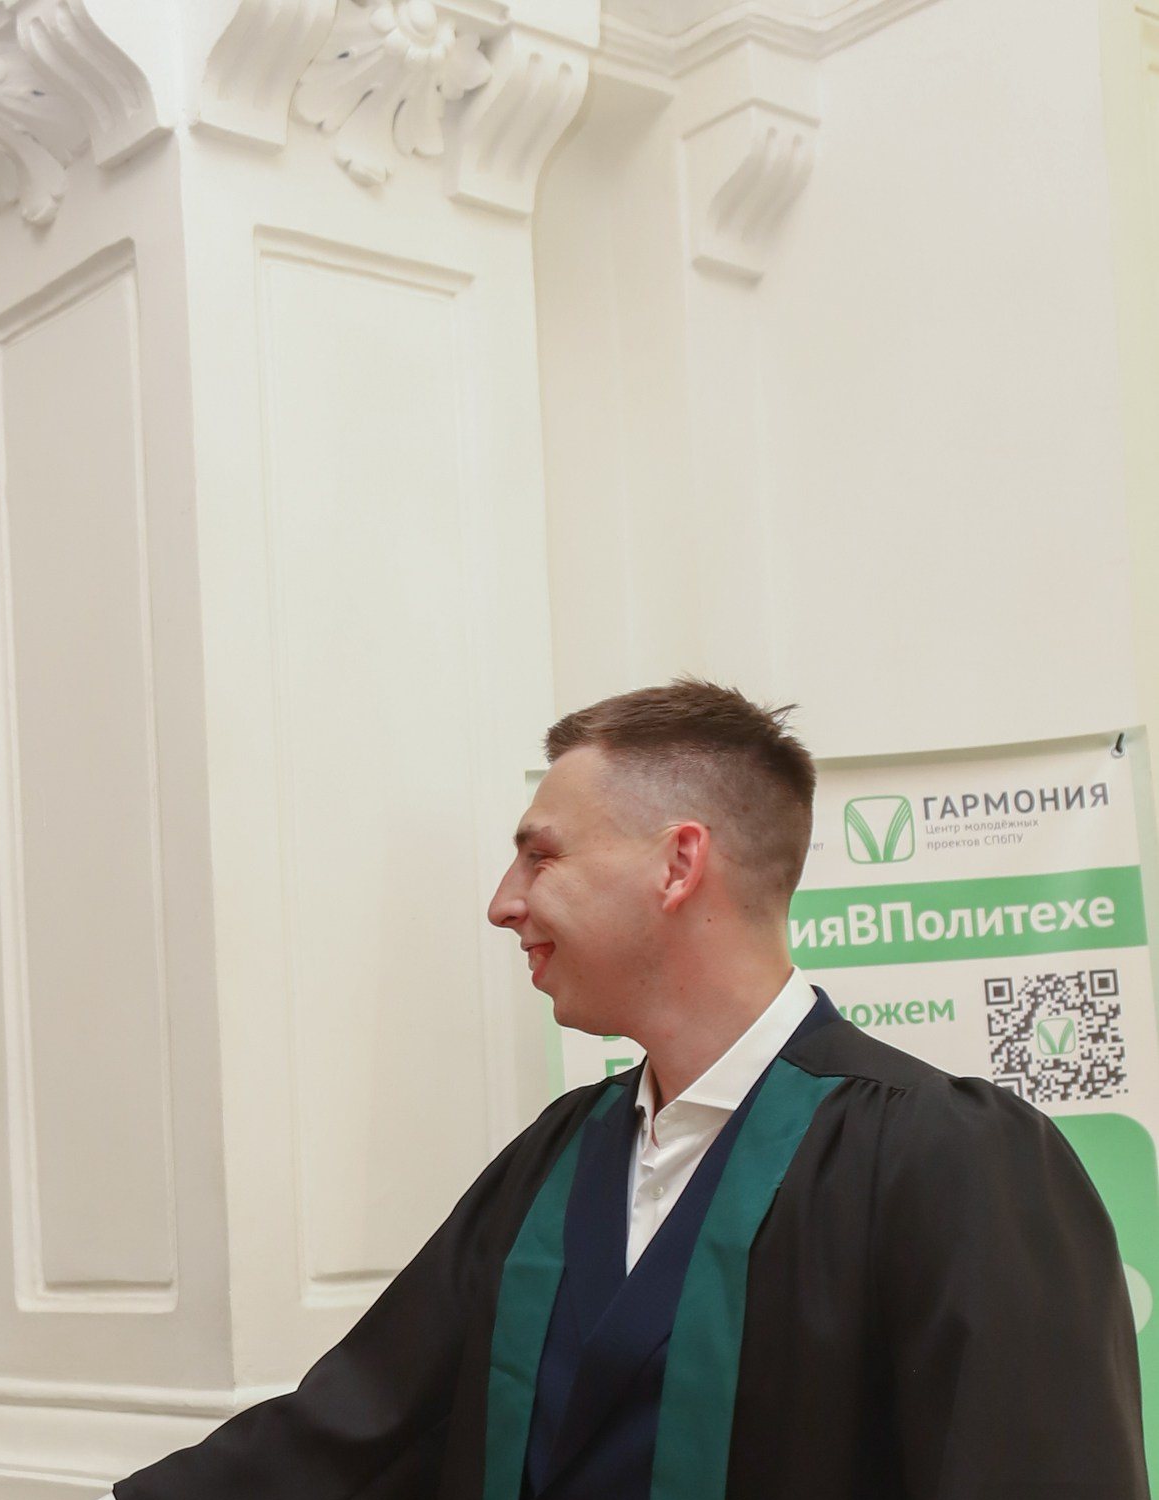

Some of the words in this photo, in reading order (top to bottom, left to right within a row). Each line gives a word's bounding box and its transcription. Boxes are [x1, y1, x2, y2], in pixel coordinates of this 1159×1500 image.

[922, 782, 1110, 821] ГАРМОНИЯ
[925, 823, 961, 835] Центр
[964, 818, 1040, 832] молодёжных
[926, 837, 981, 851] проектов
